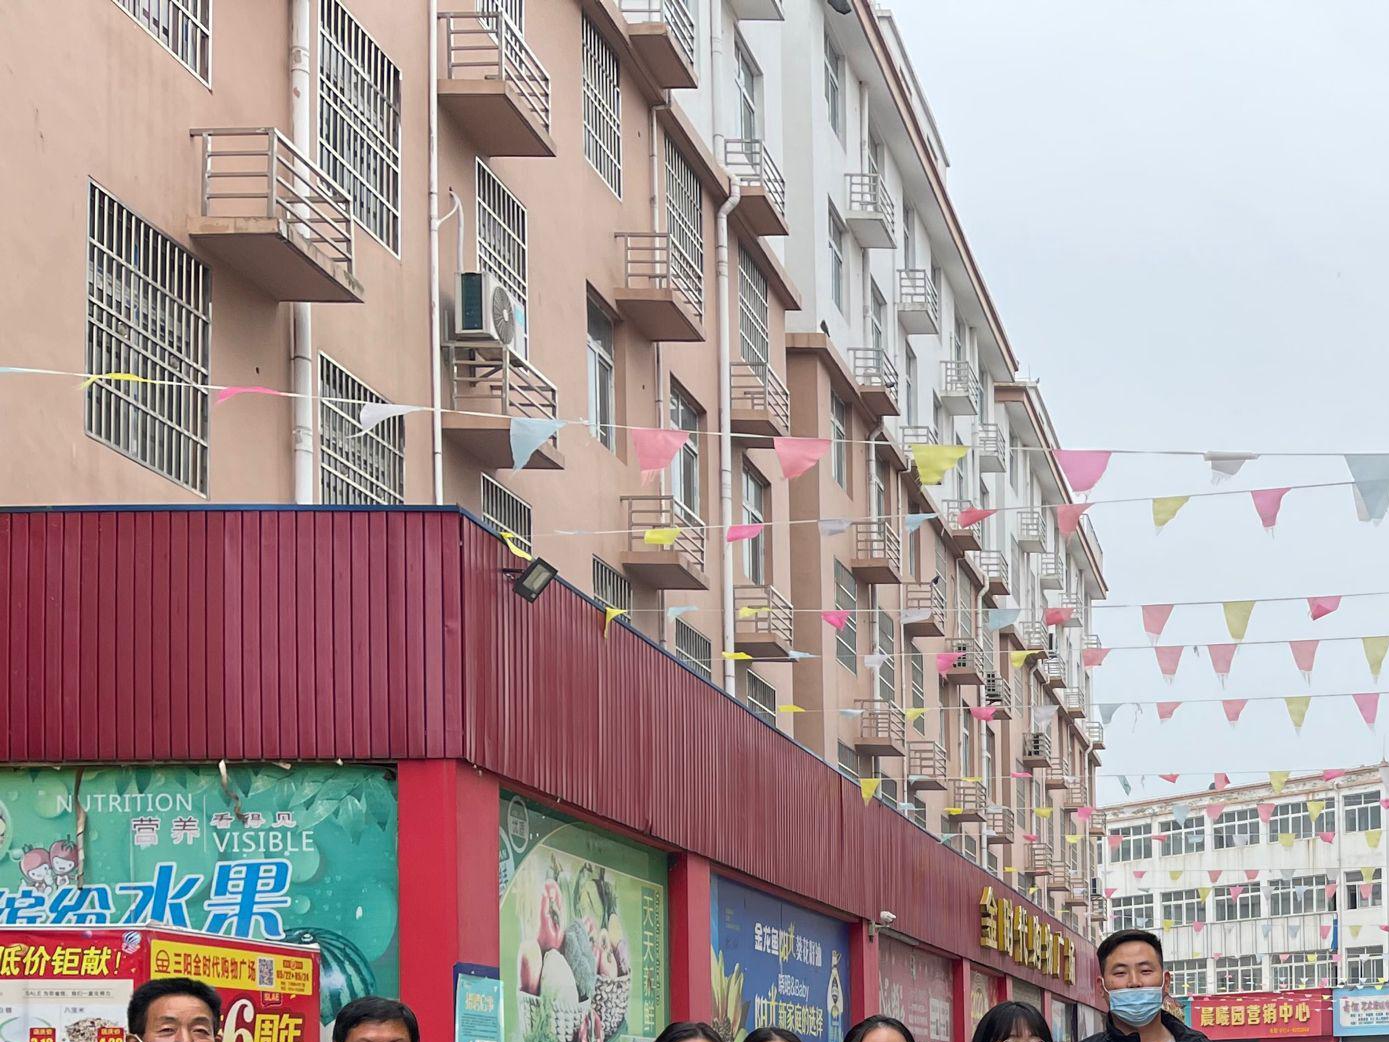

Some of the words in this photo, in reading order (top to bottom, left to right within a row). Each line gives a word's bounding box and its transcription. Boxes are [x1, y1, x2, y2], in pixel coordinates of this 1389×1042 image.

[57, 793, 192, 814] NUTRITION
[132, 816, 200, 846] 营养
[213, 831, 315, 853] VISIBLE
[173, 952, 256, 982] 三阳金时代购物广场
